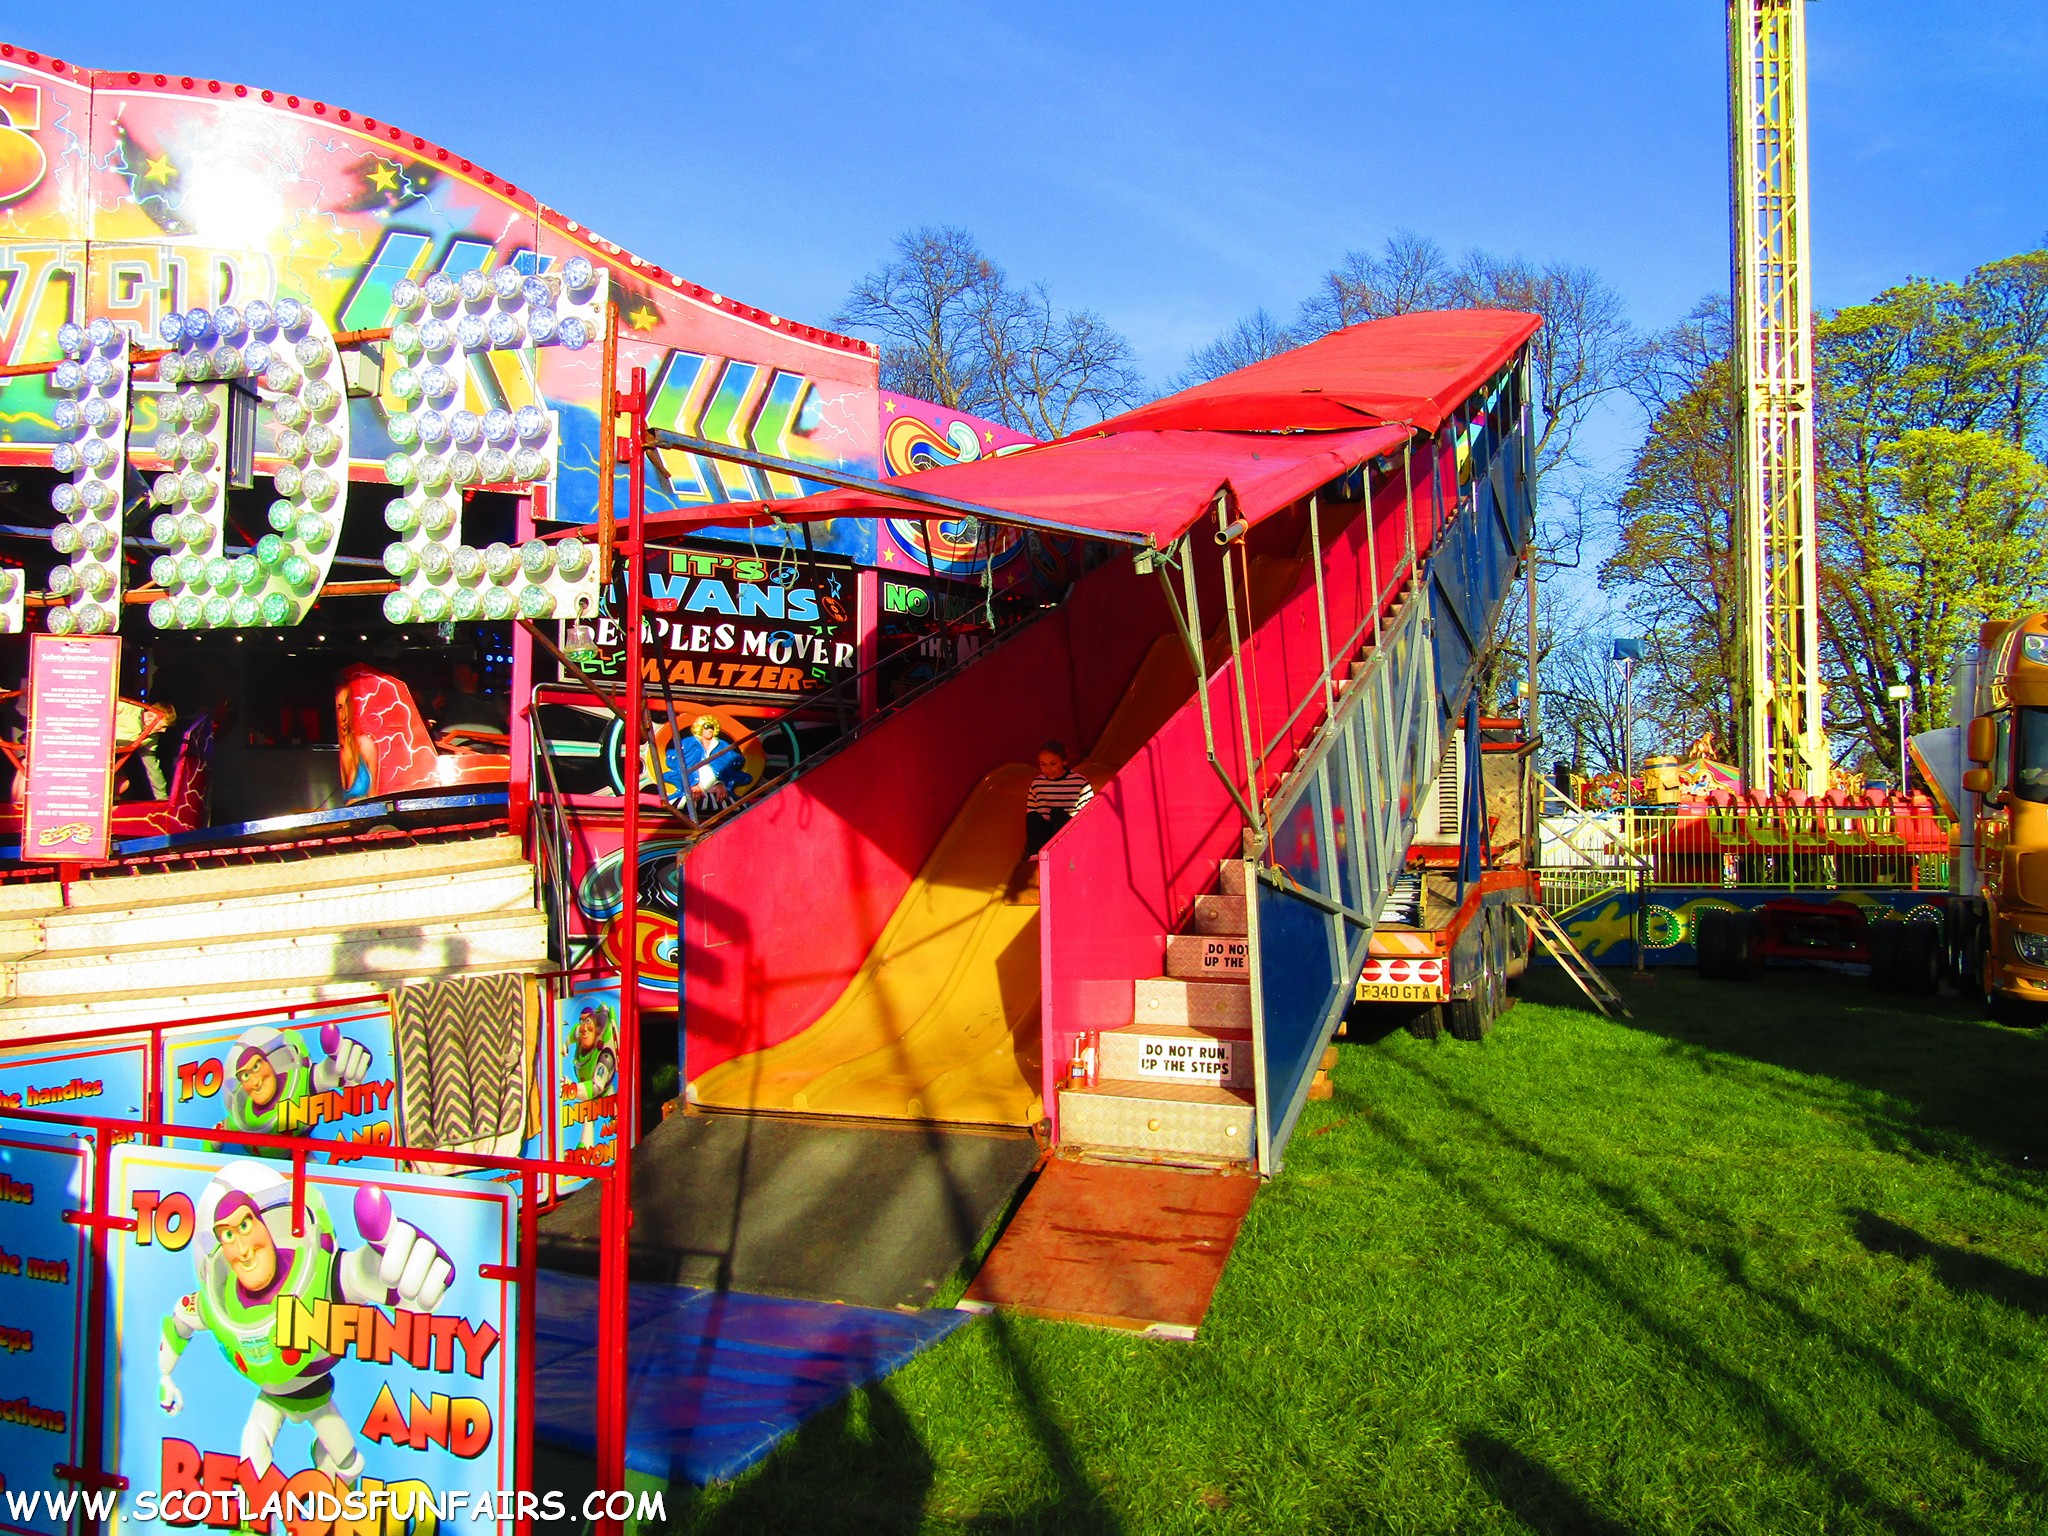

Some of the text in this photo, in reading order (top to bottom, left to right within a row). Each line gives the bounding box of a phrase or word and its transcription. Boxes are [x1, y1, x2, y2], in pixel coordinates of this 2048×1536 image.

[669, 549, 767, 582] IT'S
[883, 581, 930, 617] NO
[741, 629, 854, 668] MOVER
[1204, 957, 1244, 968] UP THE
[1208, 943, 1224, 954] DO
[1361, 984, 1430, 1000] F340 GTA
[1141, 1058, 1229, 1075] UP THE STEPS
[1146, 1044, 1225, 1059] DO NOT RUN
[27, 1078, 104, 1107] handles
[178, 1057, 224, 1103] TO
[277, 1078, 395, 1133] INFINITY
[132, 1189, 195, 1251] TO
[27, 1257, 69, 1285] mat
[275, 1295, 500, 1378] INFINITY
[362, 1381, 493, 1458] AND
[160, 1436, 439, 1536] BEYOND
